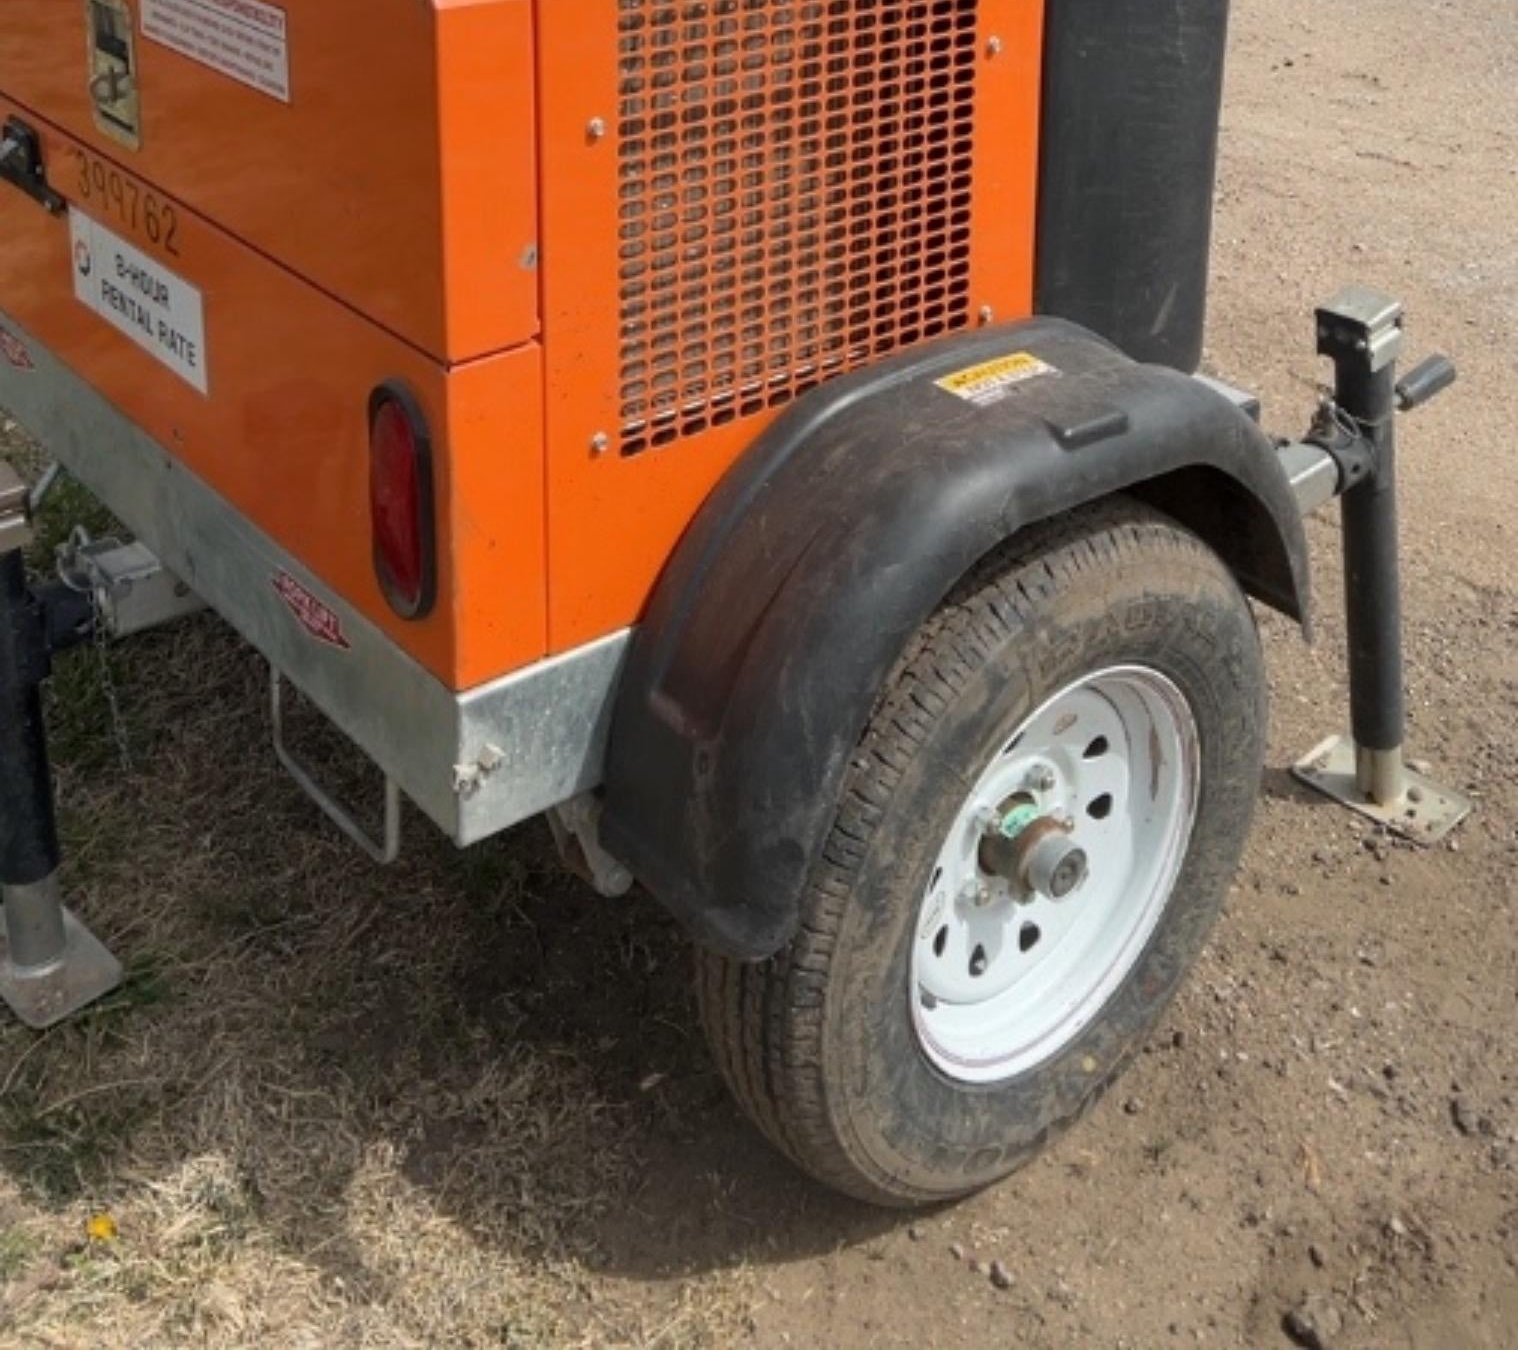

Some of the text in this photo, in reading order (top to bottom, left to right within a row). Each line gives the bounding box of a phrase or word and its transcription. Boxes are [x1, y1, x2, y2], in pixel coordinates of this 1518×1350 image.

[77, 150, 180, 258] 399762
[101, 278, 197, 368] RENTAL RATE
[115, 252, 170, 310] 8-HOUR
